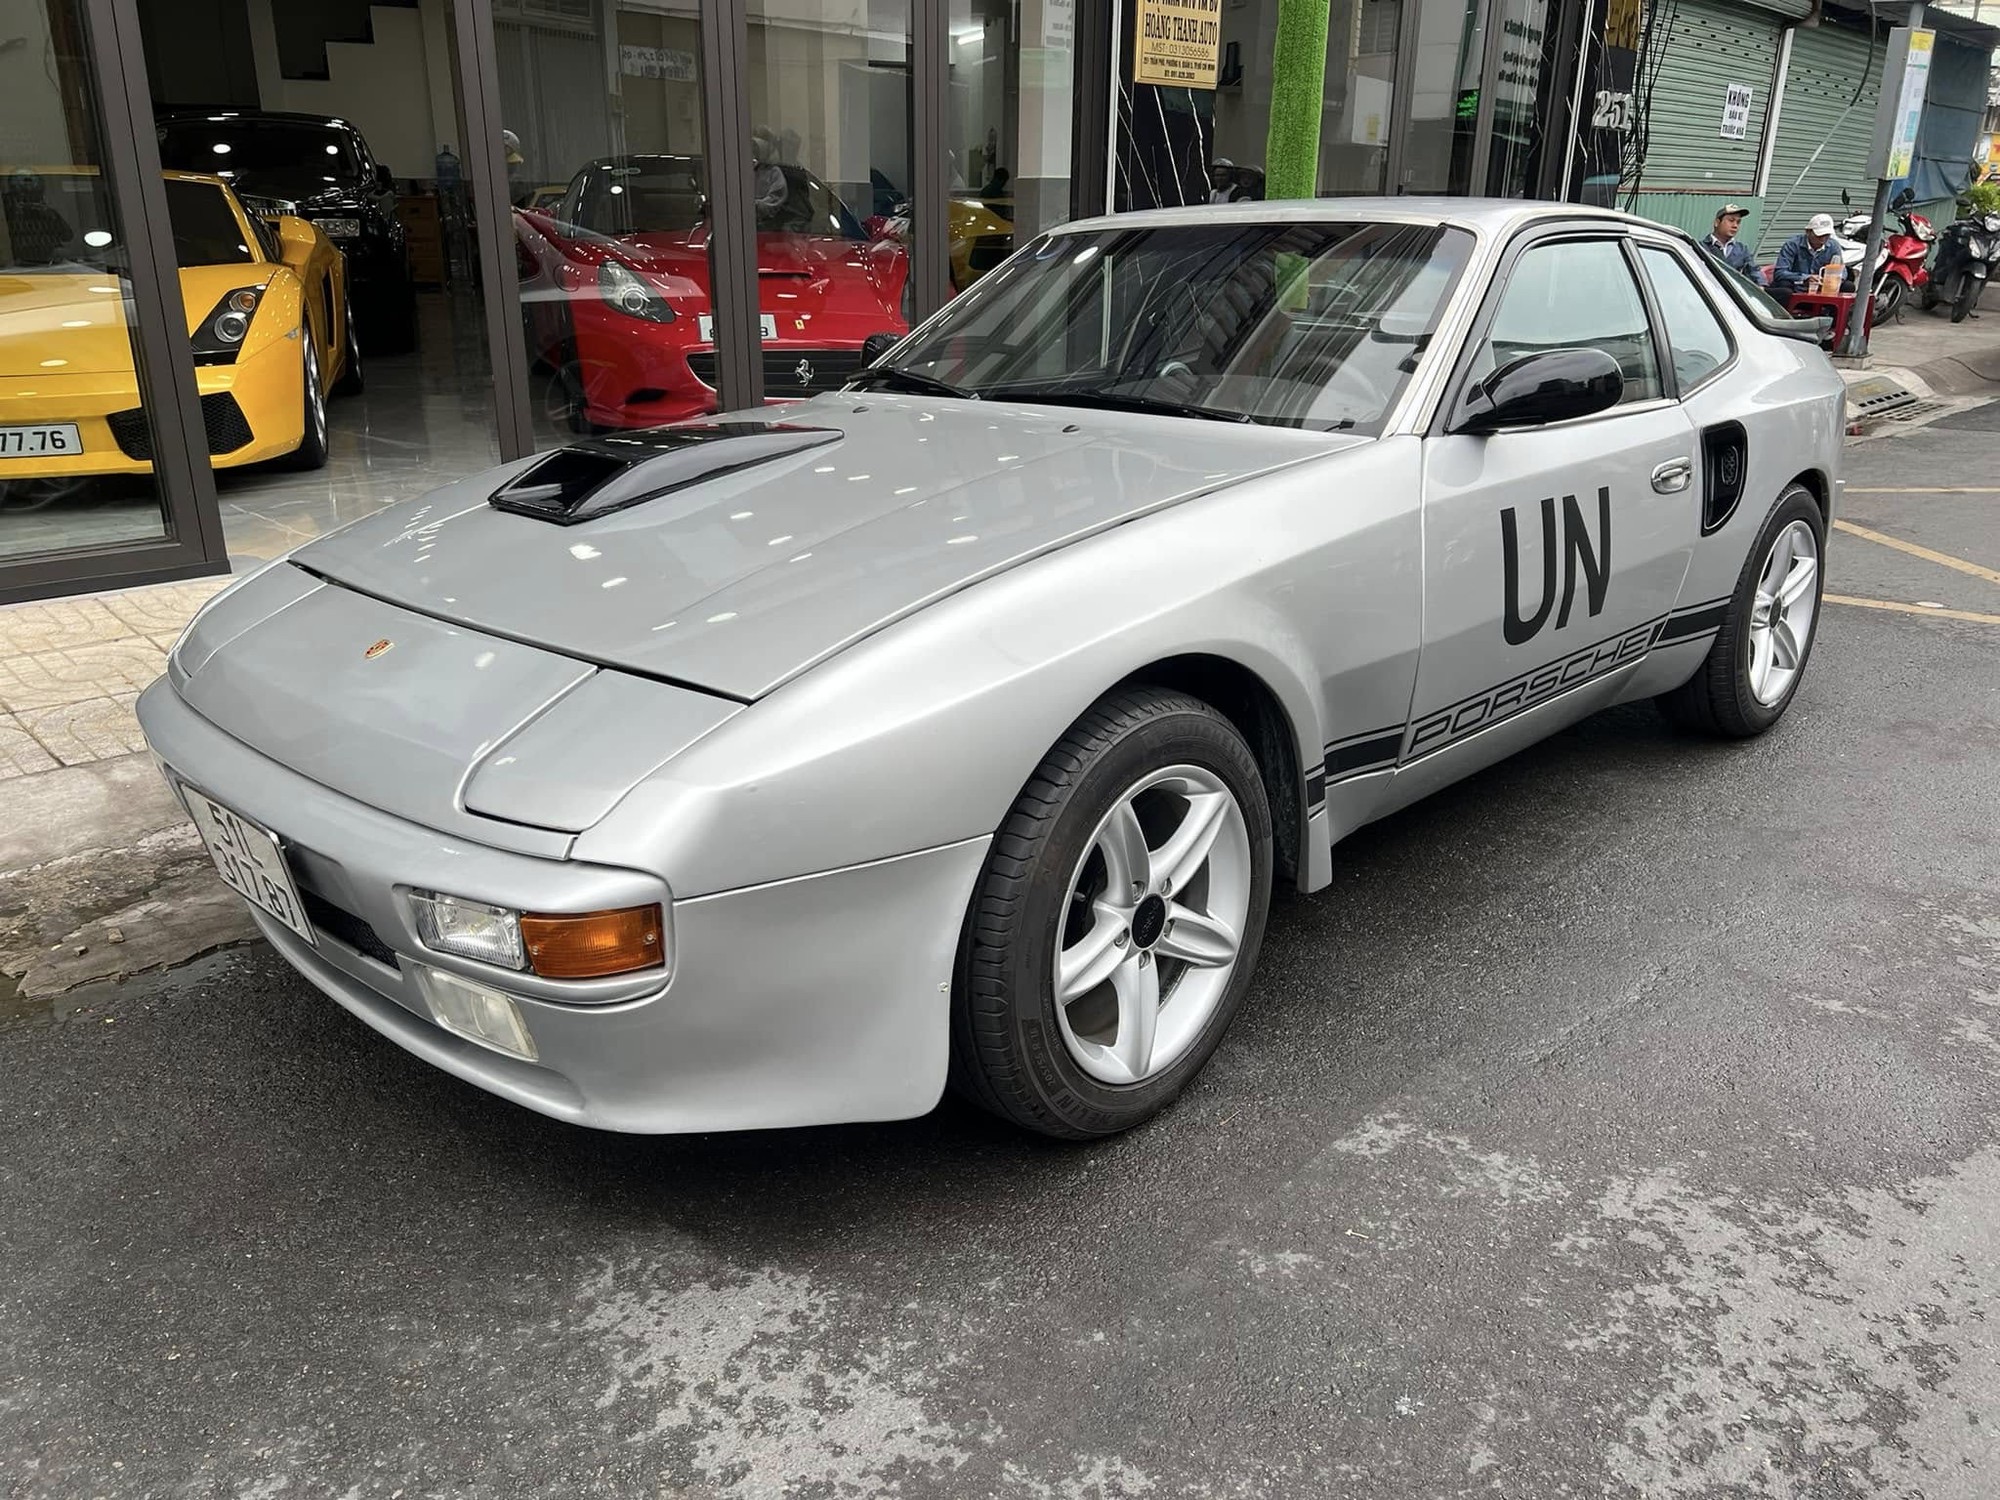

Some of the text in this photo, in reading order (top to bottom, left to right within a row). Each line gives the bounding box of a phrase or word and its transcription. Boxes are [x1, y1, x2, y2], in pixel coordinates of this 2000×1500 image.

[1145, 7, 1218, 46] HOÀNG THANH AUTO
[1500, 486, 1612, 646] UN
[1407, 626, 1651, 755] PORSCHE
[207, 801, 264, 869] 51L
